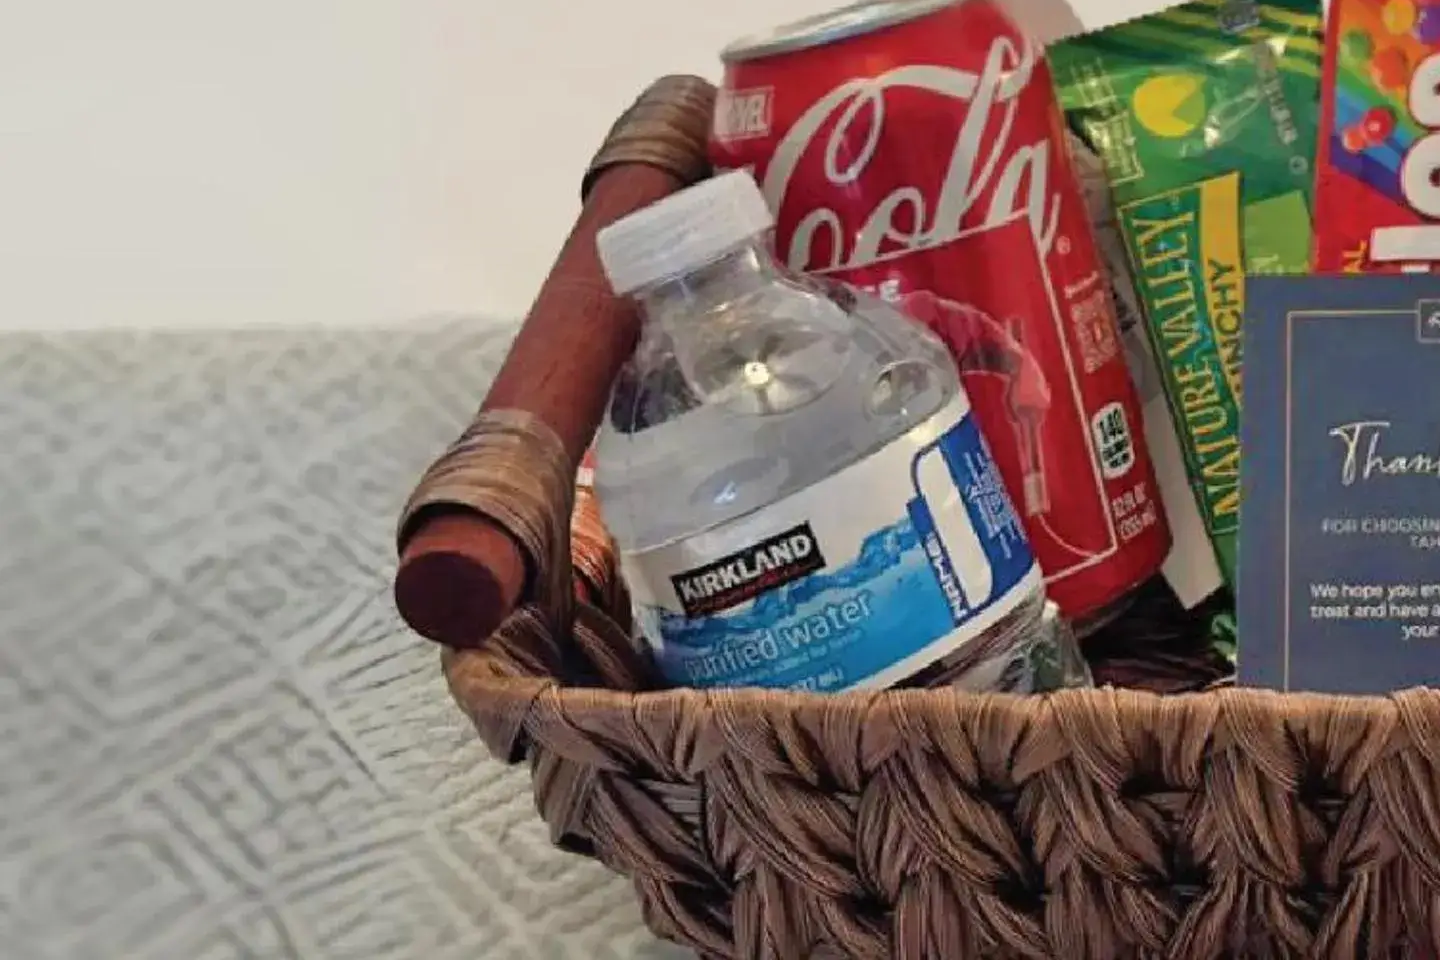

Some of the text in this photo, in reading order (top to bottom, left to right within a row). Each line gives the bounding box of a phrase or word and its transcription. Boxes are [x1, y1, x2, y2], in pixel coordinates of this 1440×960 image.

[1132, 212, 1202, 358] VALLEY
[1321, 516, 1357, 534] FOR
[680, 534, 812, 601] KIRKLAND
[1310, 583, 1338, 598] We
[1341, 583, 1383, 600] hope
[1386, 585, 1417, 601] you
[1310, 602, 1350, 618] treat
[1354, 601, 1387, 617] and
[1389, 601, 1429, 617] have
[1431, 603, 1440, 617] a
[785, 591, 873, 649] water
[1401, 623, 1440, 640] your
